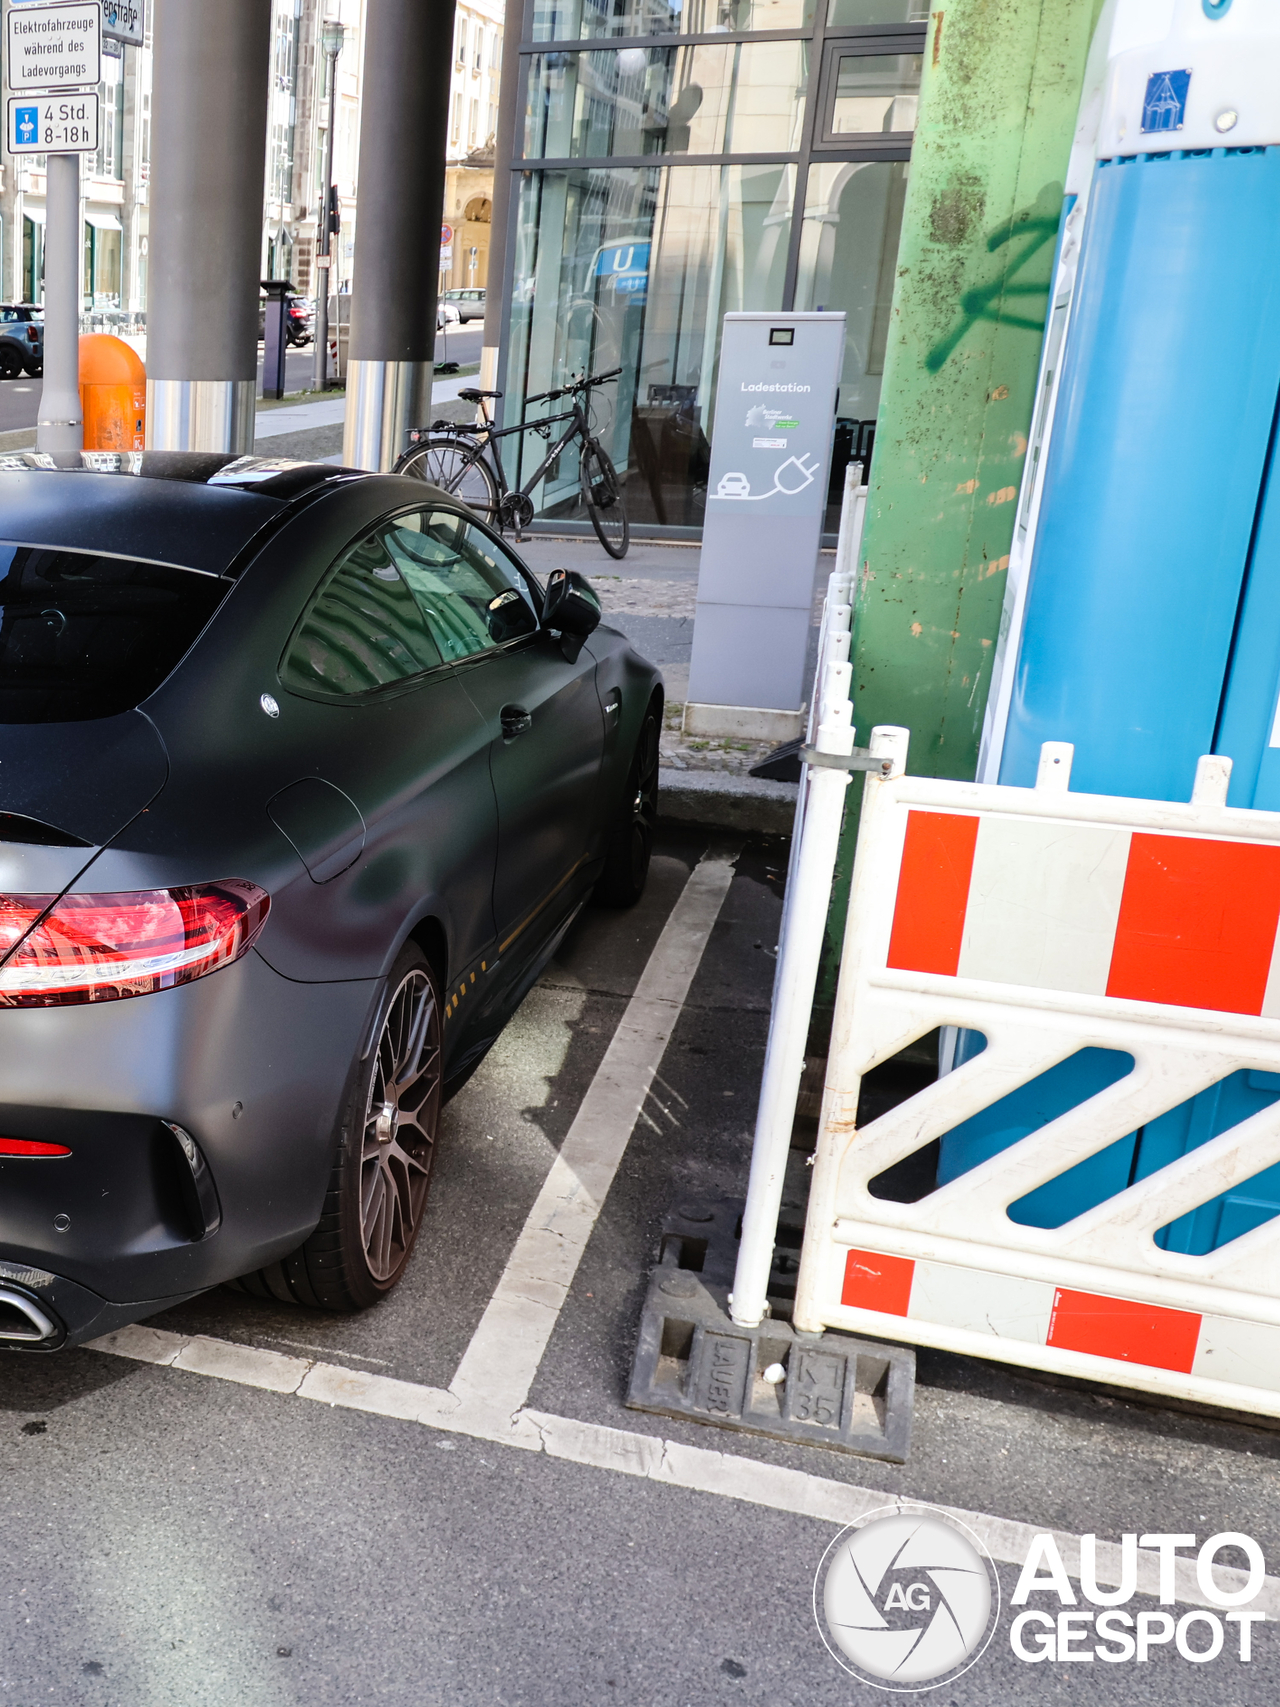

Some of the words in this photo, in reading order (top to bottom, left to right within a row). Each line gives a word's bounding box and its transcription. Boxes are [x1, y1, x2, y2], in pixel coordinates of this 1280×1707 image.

[14, 17, 94, 35] Elektrofahrzeuge
[24, 40, 64, 55] während
[68, 40, 85, 52] des
[22, 63, 87, 78] Ladevorgangs
[45, 105, 54, 122] 4
[59, 103, 90, 121] Std.
[741, 382, 811, 393] Ladestation
[706, 1341, 736, 1414] LAUER
